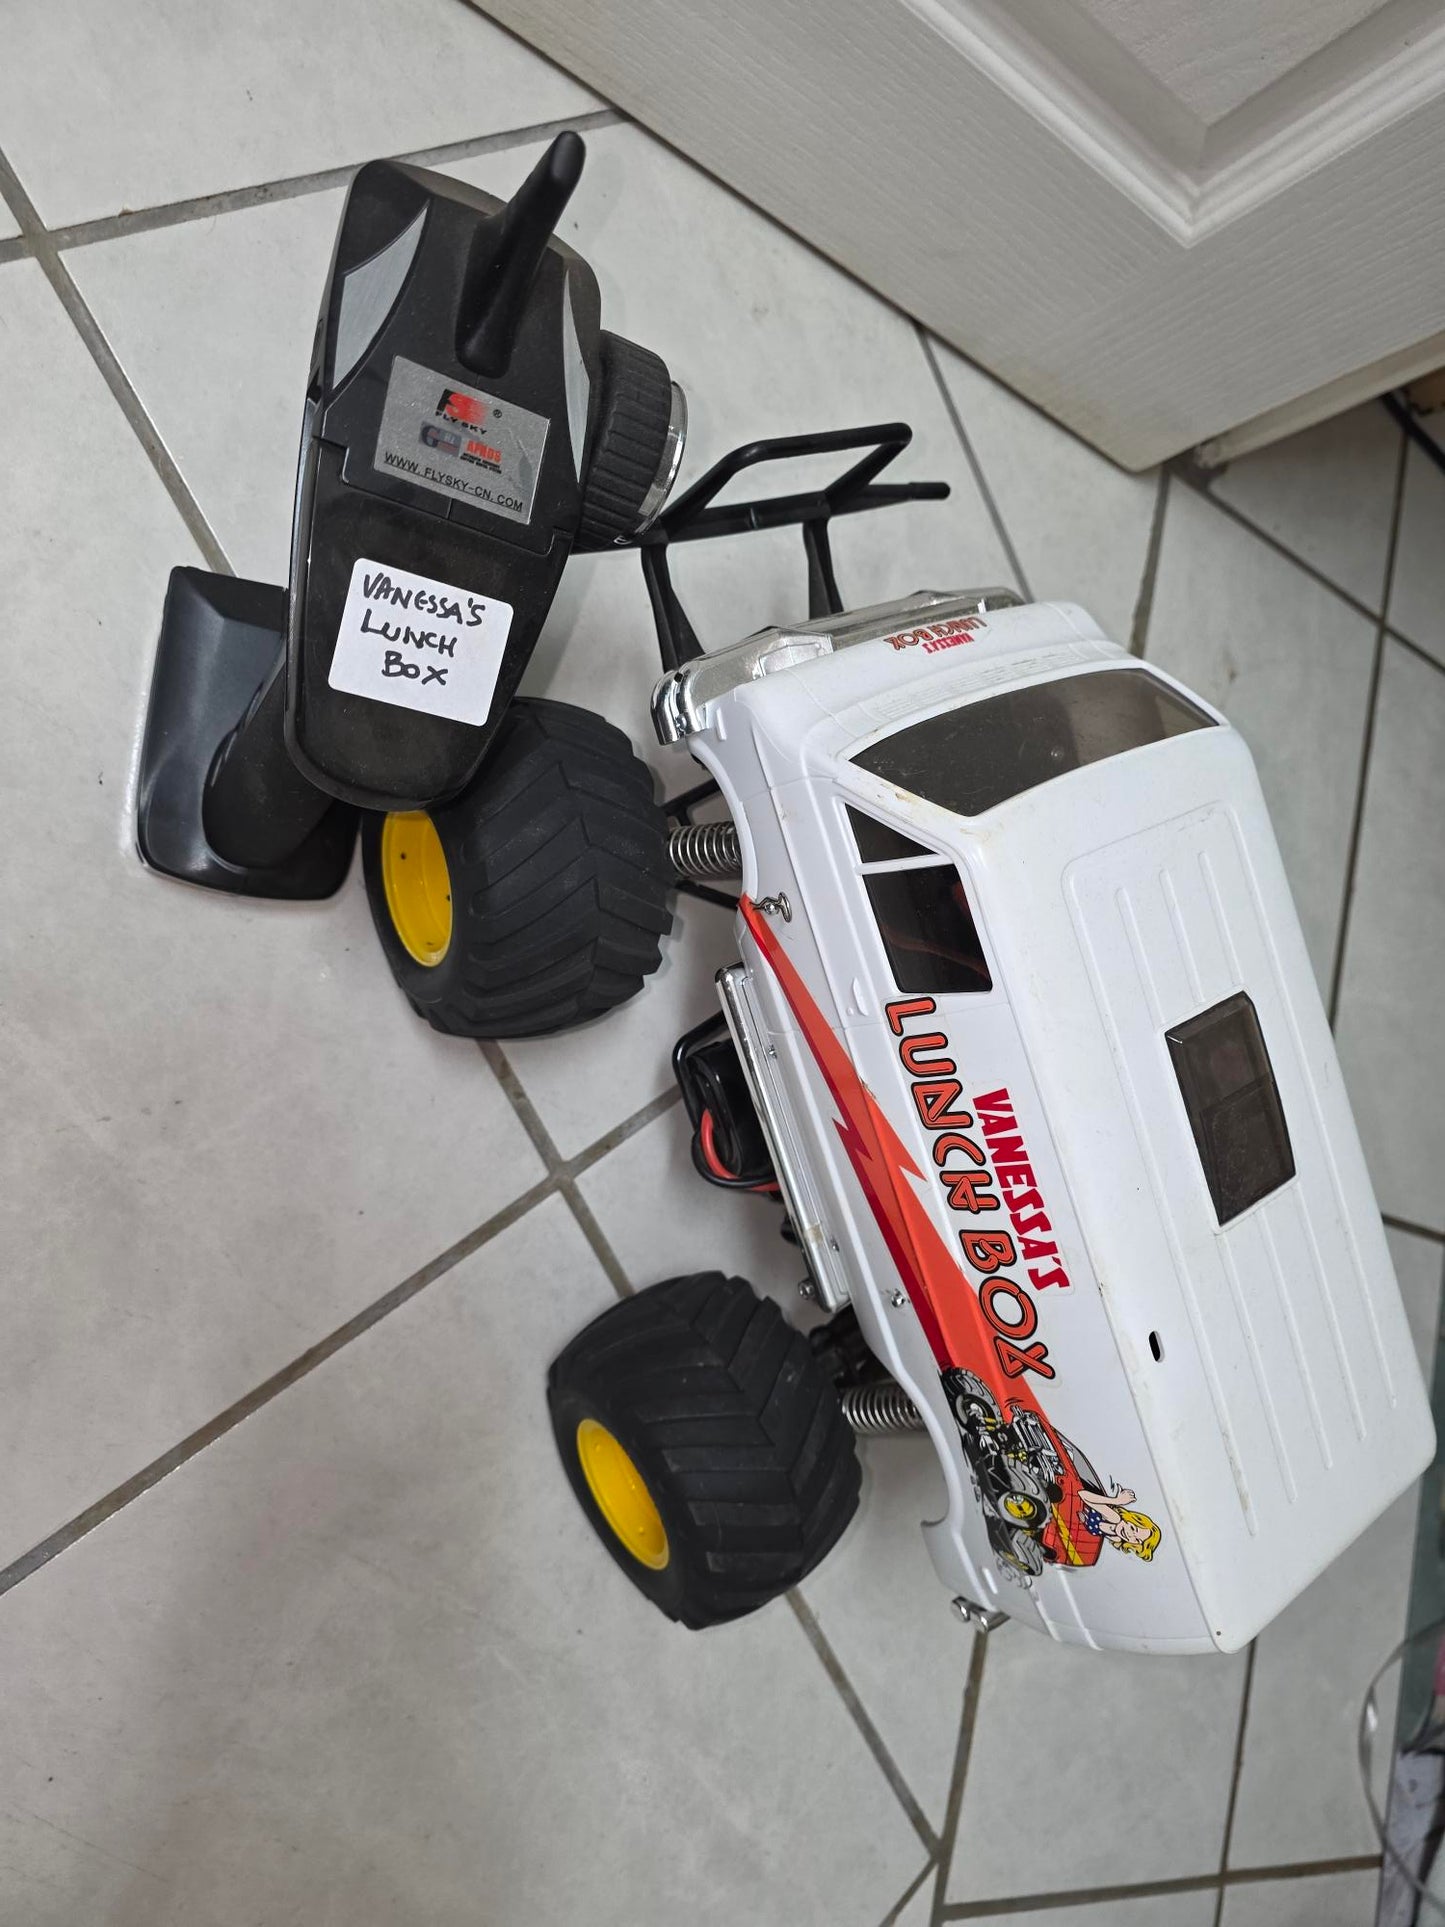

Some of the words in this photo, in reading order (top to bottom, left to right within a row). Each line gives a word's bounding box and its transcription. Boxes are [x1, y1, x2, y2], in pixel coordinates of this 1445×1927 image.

[384, 452, 523, 512] WWW.FLYSKY-CN.COM
[363, 572, 486, 627] VANESSA'S
[360, 608, 458, 658] LUNCH
[883, 628, 934, 650] BOX
[927, 616, 987, 638] LUNCH
[381, 650, 449, 686] BOX
[885, 996, 1000, 1215] LUNCH
[959, 1229, 1056, 1380] BOX
[972, 1087, 1070, 1292] VANESSA'S
